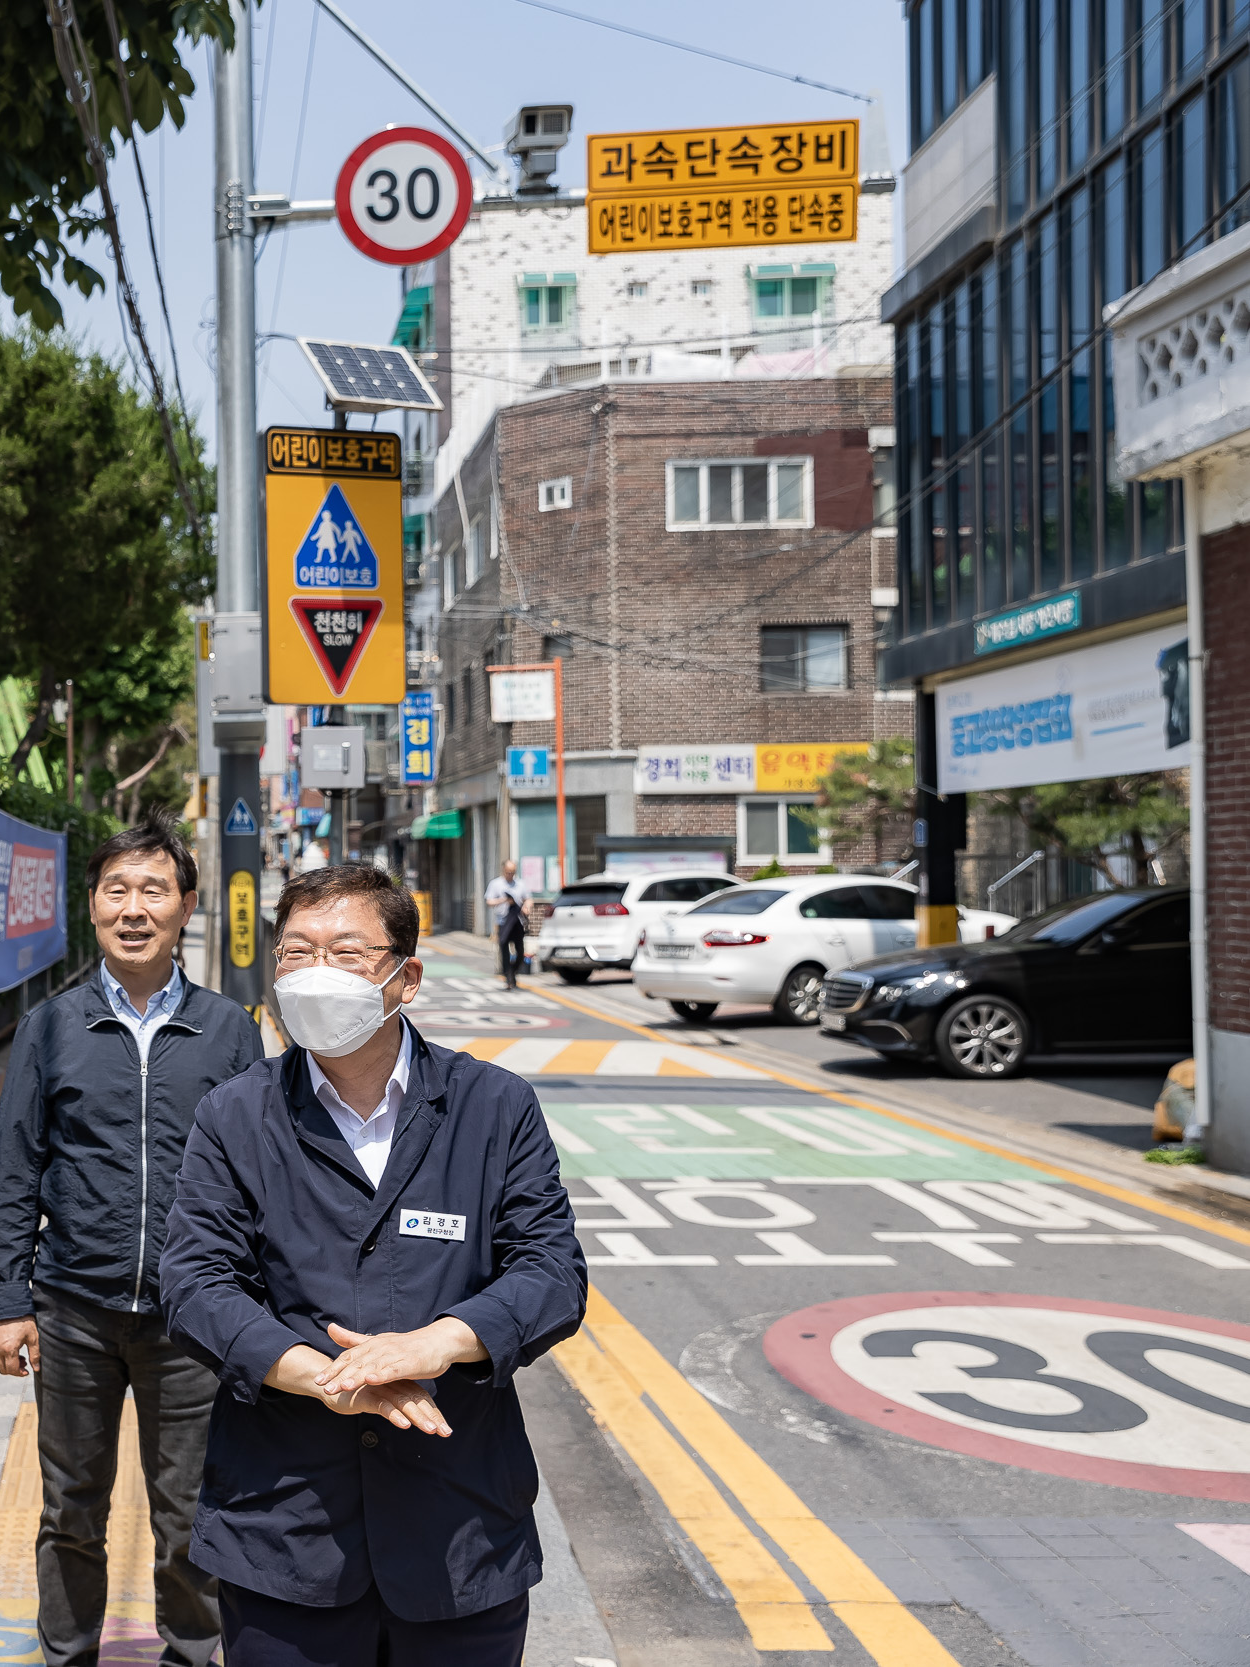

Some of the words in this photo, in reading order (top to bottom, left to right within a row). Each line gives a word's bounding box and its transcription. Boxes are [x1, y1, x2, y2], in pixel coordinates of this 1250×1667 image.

[600, 130, 847, 182] 과속단속장비
[366, 167, 440, 222] 30
[599, 200, 734, 242] 어린이보호구역
[741, 195, 779, 237] 적용
[787, 193, 844, 234] 단속중
[271, 433, 396, 473] 어린이보호구역
[299, 565, 373, 586] 어린이보호
[314, 610, 363, 634] 천천히
[322, 634, 354, 647] SLOW
